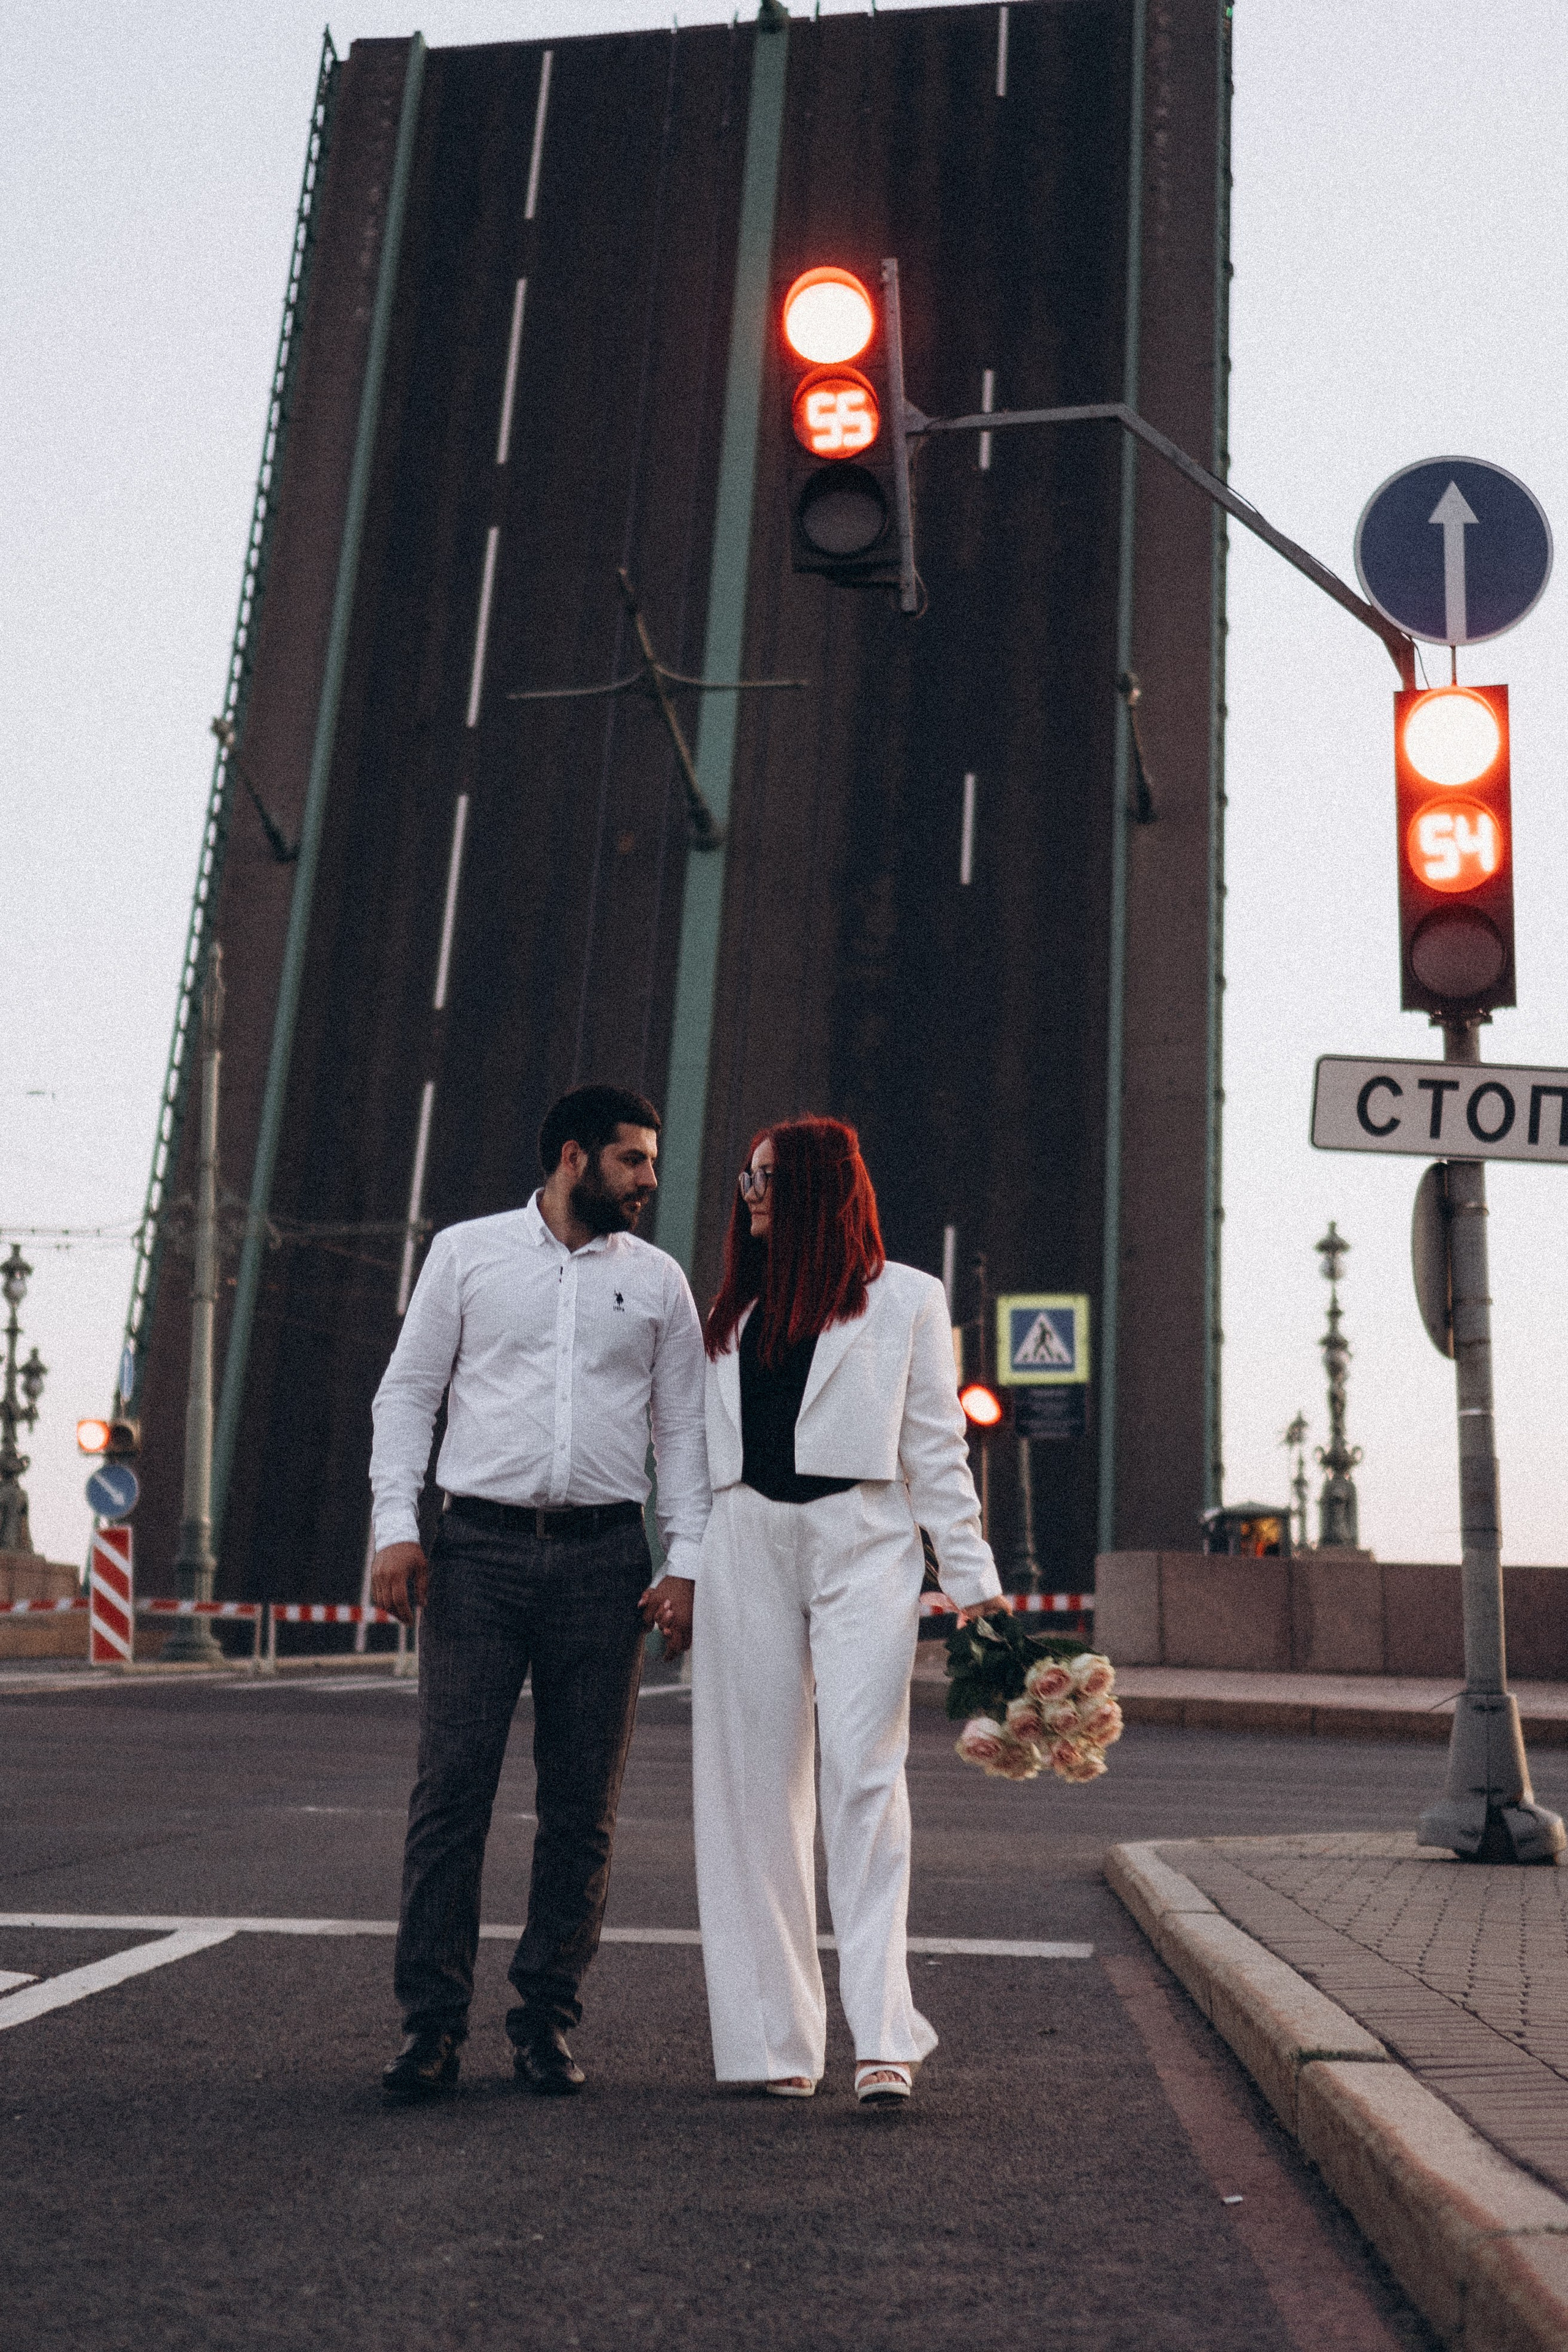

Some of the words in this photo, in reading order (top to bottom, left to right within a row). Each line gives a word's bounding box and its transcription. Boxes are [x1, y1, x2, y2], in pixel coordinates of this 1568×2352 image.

[805, 390, 874, 450] 55
[1418, 813, 1496, 881] 54
[1357, 1075, 1568, 1146] СТОП
